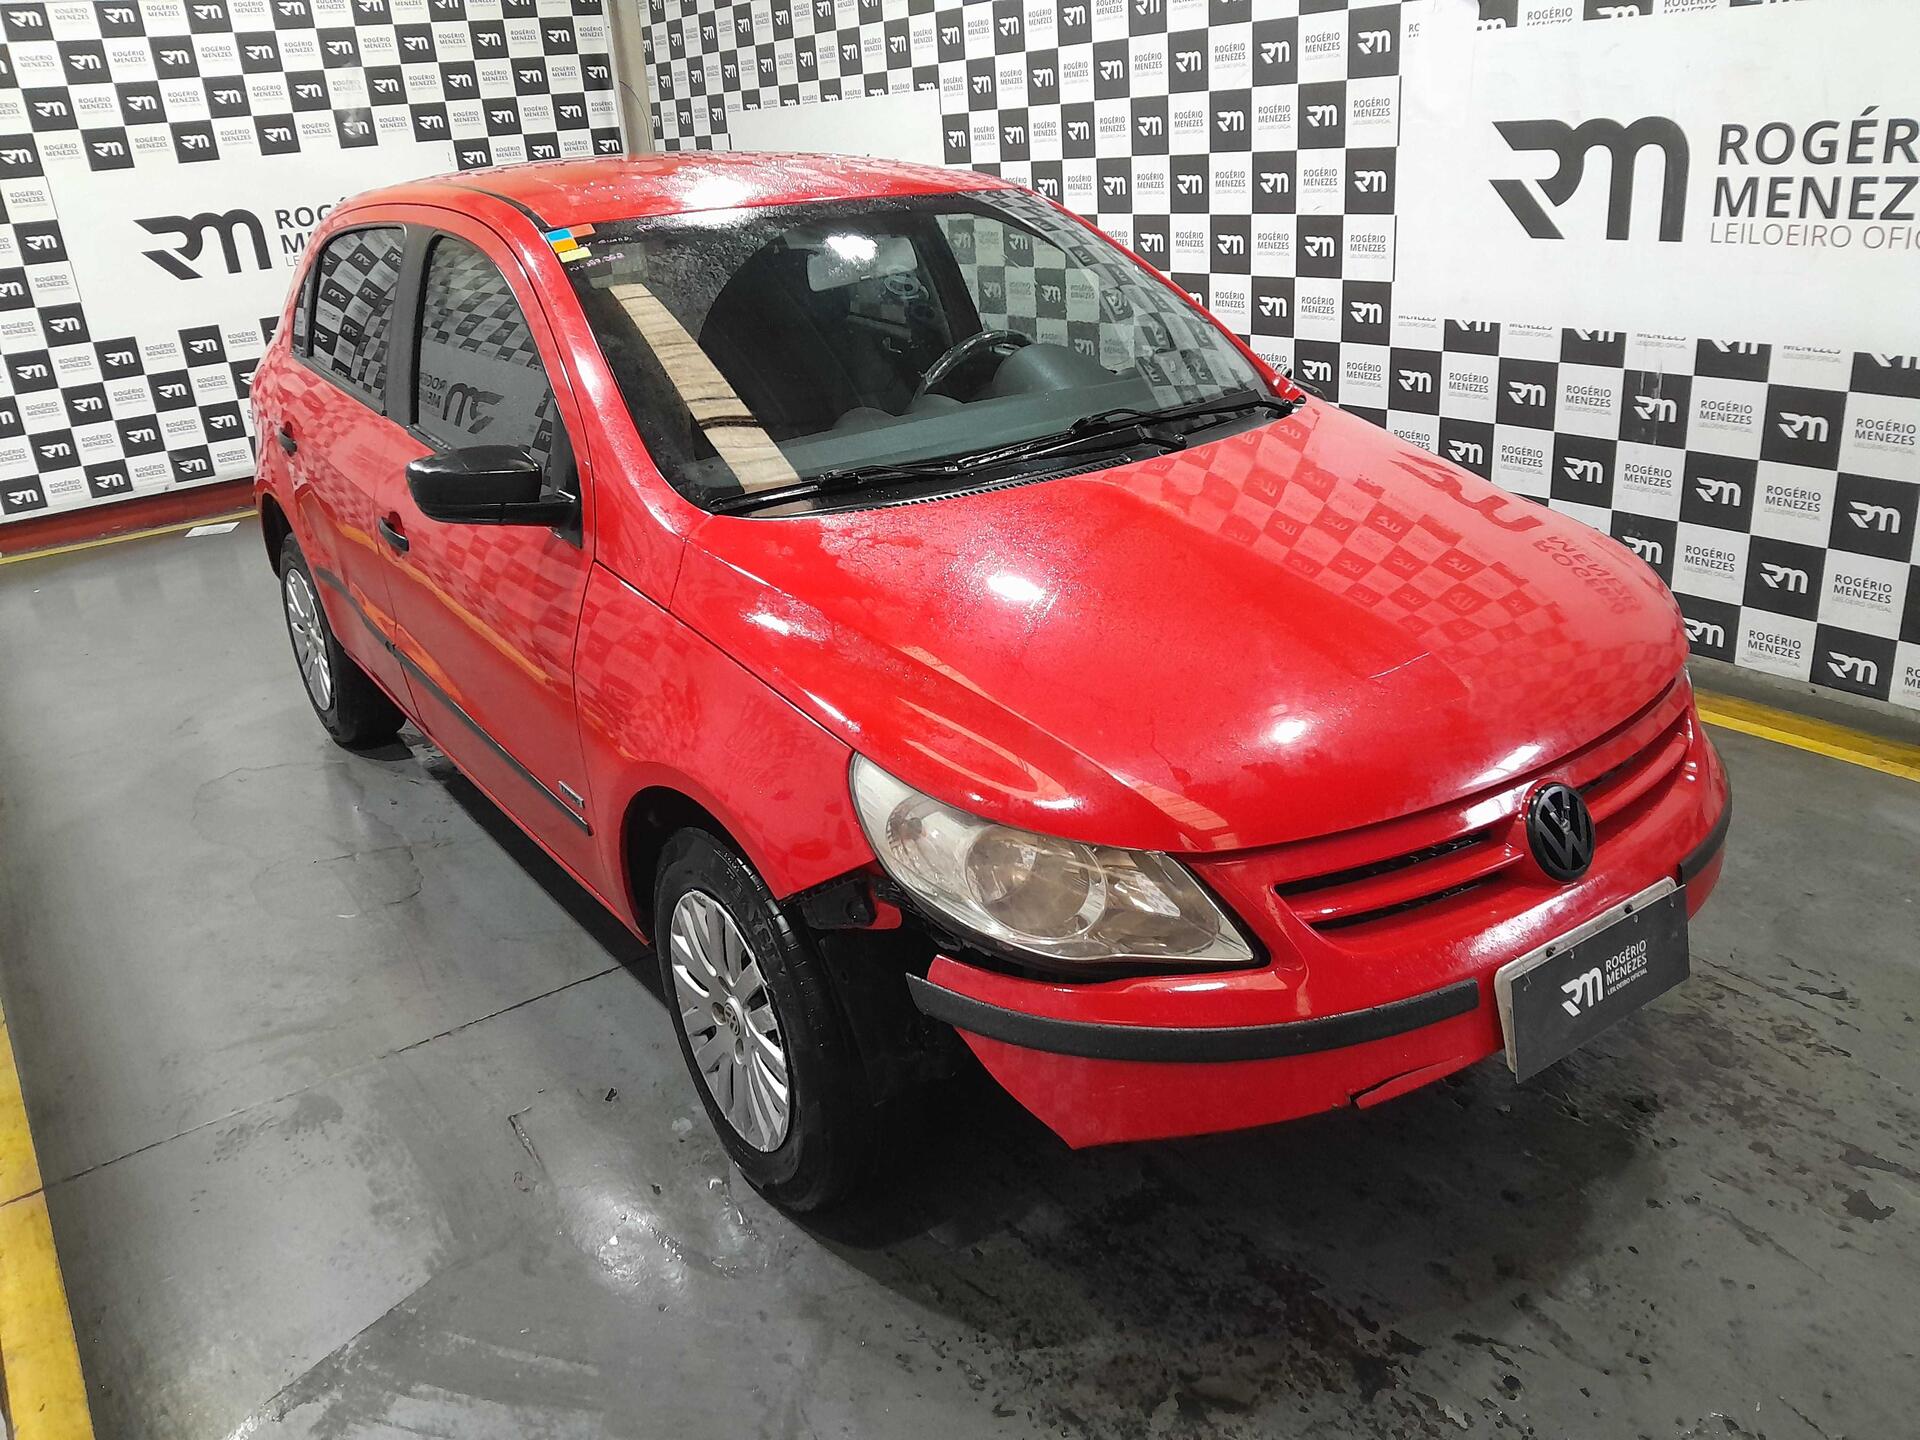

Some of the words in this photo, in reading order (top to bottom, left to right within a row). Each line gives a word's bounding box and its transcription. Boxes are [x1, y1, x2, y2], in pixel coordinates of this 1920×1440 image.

[1028, 8, 1052, 18] ROGÉRIO
[1527, 8, 1573, 20] ROGÉRIO
[1028, 16, 1053, 26] MENEZES
[968, 27, 989, 35] MENEZES
[1305, 31, 1341, 44] ROGÉRIO
[1214, 42, 1246, 54] ROGÉRIO
[1305, 41, 1341, 53] MENEZES
[1134, 52, 1162, 63] ROGÉRIO
[1214, 51, 1246, 63] MENEZES
[1063, 61, 1089, 71] ROGÉRIO
[1134, 60, 1163, 71] MENEZES
[1000, 69, 1023, 78] ROGÉRIO
[1064, 69, 1089, 79] MENEZES
[1000, 76, 1023, 86] MENEZES
[1353, 97, 1391, 109] ROGÉRIO
[1258, 104, 1291, 114] ROGÉRIO
[1353, 107, 1391, 118] MENEZES
[1099, 116, 1126, 125] ROGÉRIO
[1174, 110, 1204, 120] ROGÉRIO
[1258, 113, 1291, 123] MENEZES
[1033, 121, 1057, 130] ROGÉRIO
[1100, 123, 1126, 133] MENEZES
[1174, 118, 1204, 128] MENEZES
[1033, 128, 1057, 137] MENEZES
[1137, 172, 1164, 181] ROGÉRIO
[1215, 169, 1246, 180] ROGÉRIO
[1303, 167, 1338, 178] ROGÉRIO
[1067, 174, 1092, 183] ROGÉRIO
[1215, 179, 1246, 188] MENEZES
[1303, 177, 1338, 187] MENEZES
[1068, 182, 1093, 191] MENEZES
[1137, 181, 1165, 189] MENEZES
[1175, 230, 1204, 240] ROGÉRIO
[1257, 232, 1290, 241] ROGÉRIO
[1350, 233, 1386, 244] ROGÉRIO
[1710, 222, 1852, 248] LEILOEIRO
[1176, 239, 1204, 248] MENEZES
[1257, 241, 1290, 250] MENEZES
[1350, 243, 1386, 253] MENEZES
[1215, 290, 1245, 301] ROGÉRIO
[1301, 296, 1335, 306] ROGÉRIO
[1215, 299, 1245, 309] MENEZES
[1301, 304, 1335, 316] MENEZES
[1346, 361, 1382, 373] ROGÉRIO
[1346, 370, 1382, 382] MENEZES
[1449, 372, 1489, 384] ROGÉRIO
[1449, 381, 1489, 394] MENEZES
[1566, 385, 1612, 398] ROGÉRIO
[1565, 394, 1611, 408] MENEZES
[1700, 400, 1753, 414] ROGÉRIO
[1699, 410, 1752, 425] MENEZES
[1856, 418, 1917, 435] ROGÉRIO
[1854, 429, 1916, 446] MENEZES
[1501, 445, 1544, 459] ROGÉRIO
[1501, 454, 1543, 468] MENEZES
[1625, 463, 1673, 479] ROGÉRIO
[1624, 472, 1672, 489] MENEZES
[1766, 485, 1822, 502] ROGÉRIO
[1765, 495, 1821, 513] MENEZES
[1685, 545, 1736, 562] ROGÉRIO
[1684, 554, 1735, 573] MENEZES
[1835, 574, 1893, 593] ROGÉRIO
[1833, 584, 1892, 605] MENEZES
[1749, 629, 1802, 650] ROGÉRIO
[1748, 639, 1801, 660] MENEZES
[1605, 940, 1647, 972] ROGÉRIO
[1606, 952, 1647, 986] MENEZES
